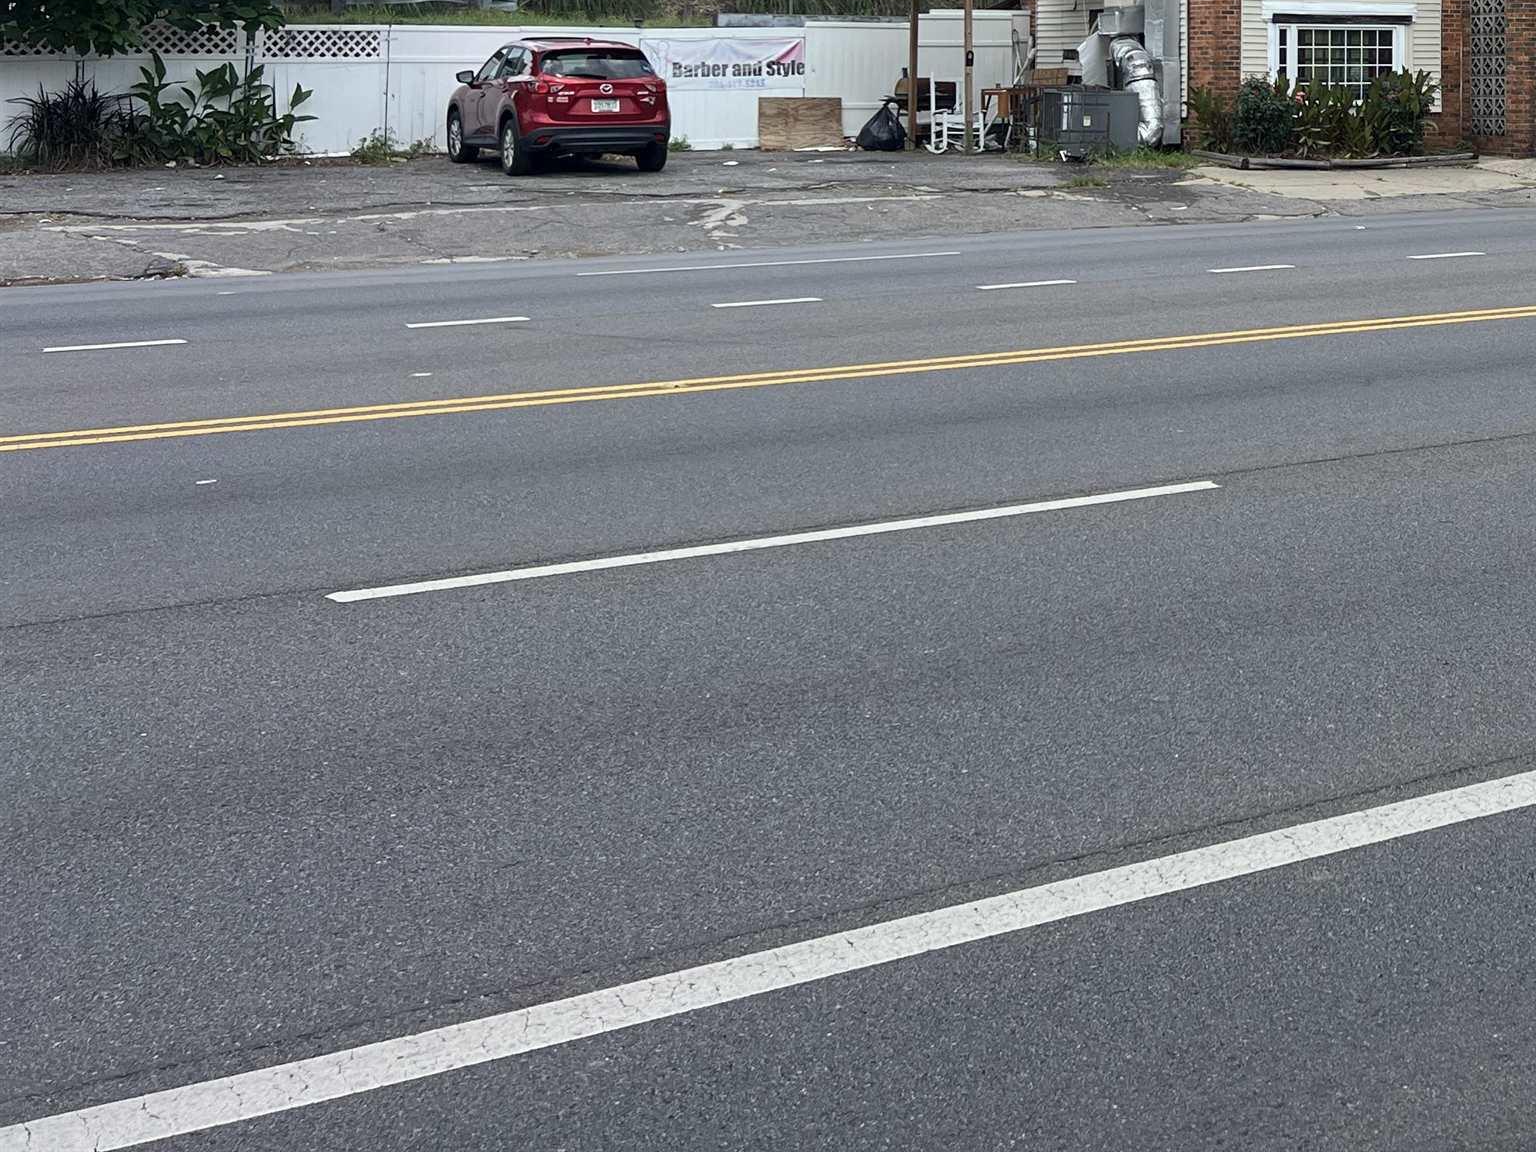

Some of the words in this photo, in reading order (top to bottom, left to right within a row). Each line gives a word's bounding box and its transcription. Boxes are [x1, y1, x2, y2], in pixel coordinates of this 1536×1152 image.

[672, 61, 728, 78] Barber
[732, 60, 762, 77] and
[766, 59, 806, 78] Style
